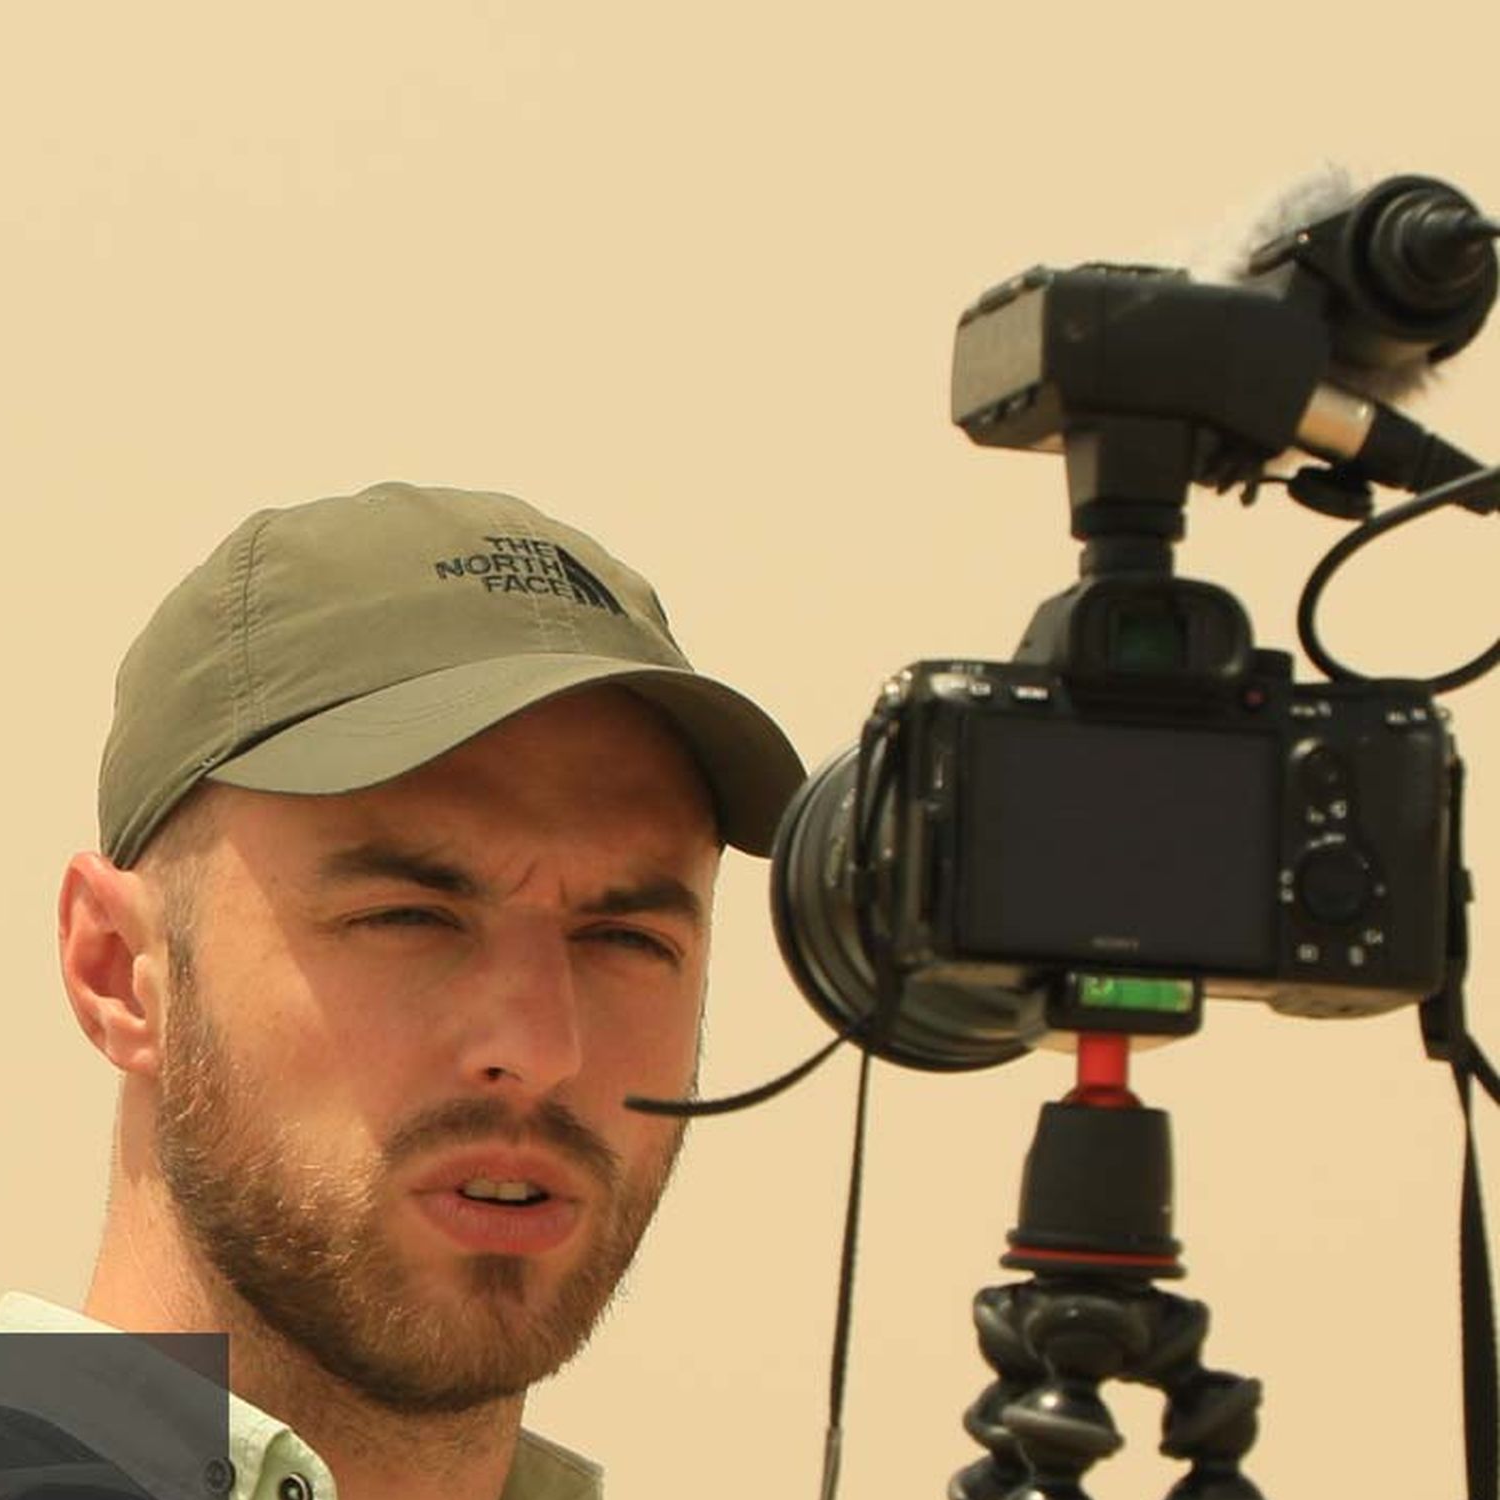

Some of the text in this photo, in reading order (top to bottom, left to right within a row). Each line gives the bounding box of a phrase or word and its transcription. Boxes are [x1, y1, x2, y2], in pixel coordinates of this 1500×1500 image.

[484, 537, 554, 556] THE
[435, 555, 563, 580] NORTH
[484, 575, 572, 599] FACE
